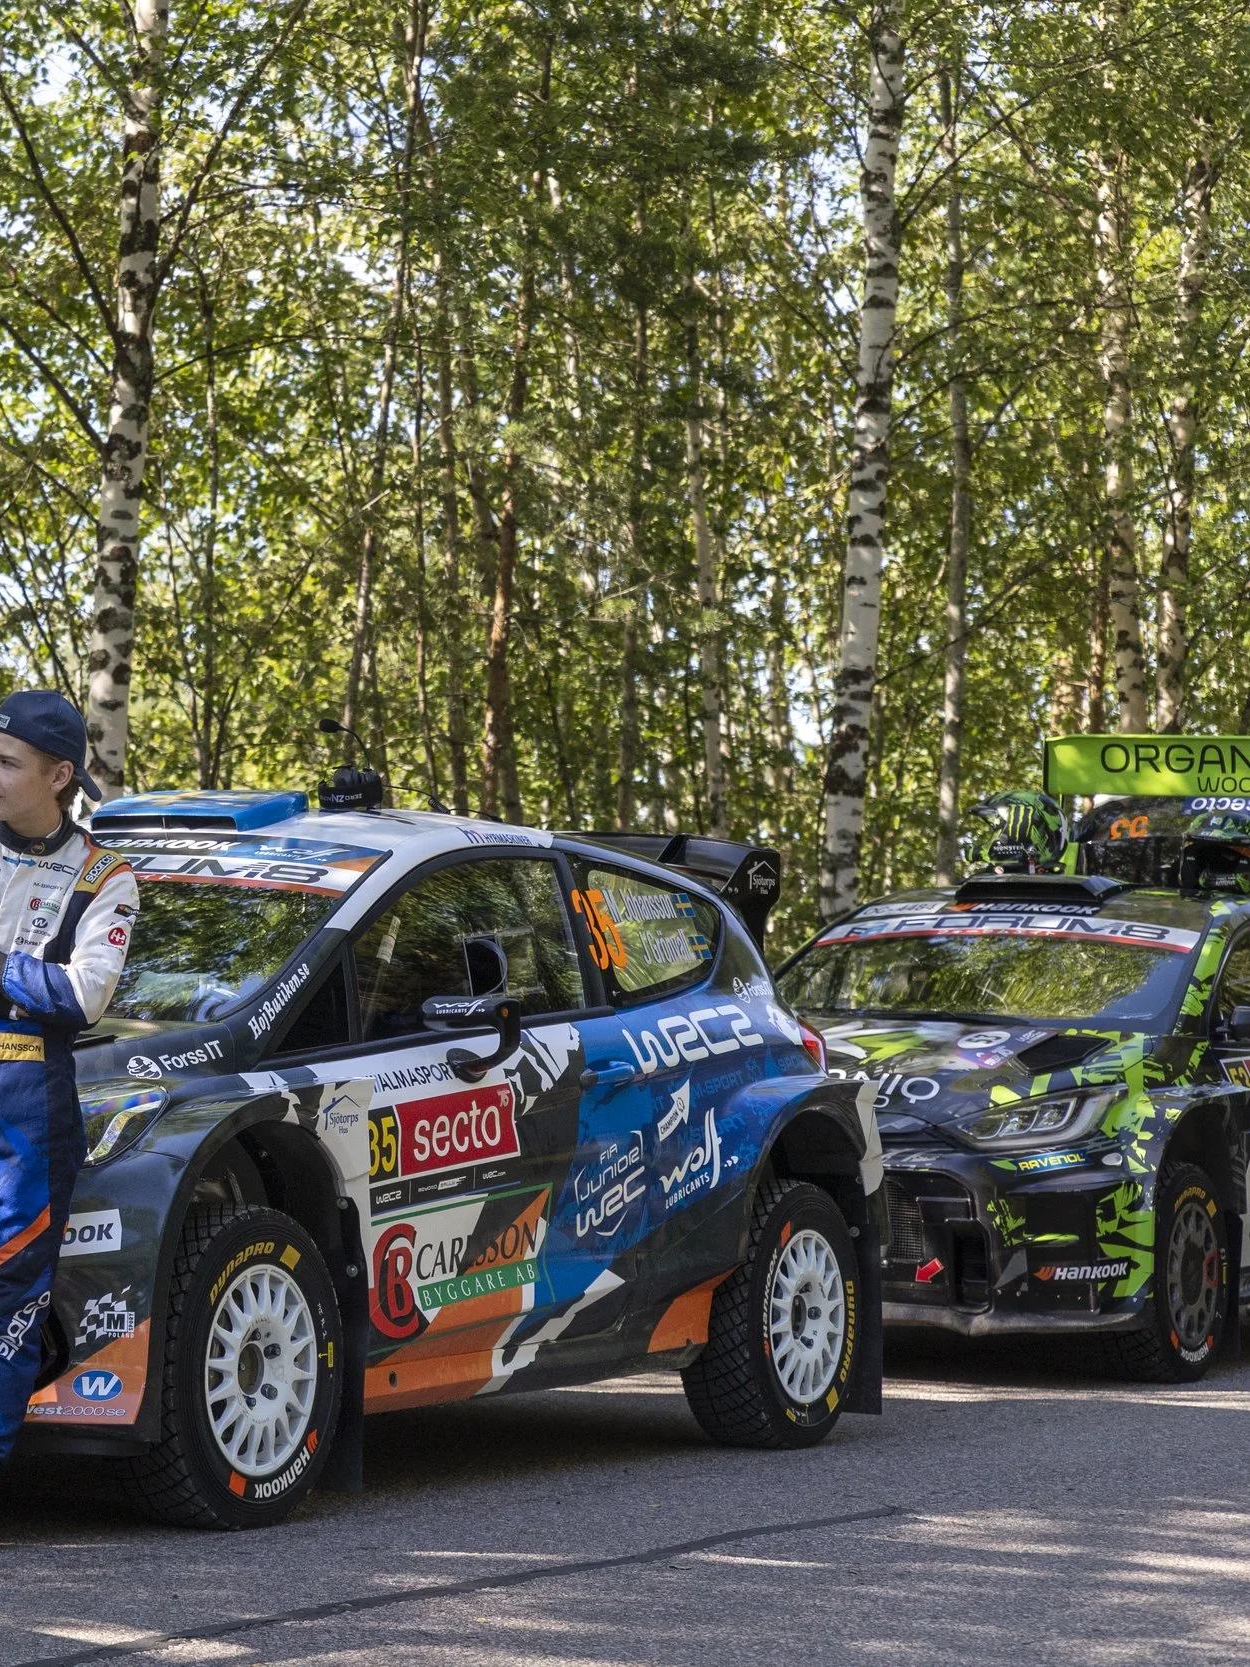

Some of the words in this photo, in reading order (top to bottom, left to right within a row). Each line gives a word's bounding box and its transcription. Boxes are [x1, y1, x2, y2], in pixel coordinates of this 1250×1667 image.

[85, 854, 117, 883] sparco
[619, 888, 677, 921] Johansson
[571, 889, 627, 971] 35
[894, 915, 1171, 941] FORUM8
[158, 1048, 208, 1071] Forss
[207, 1039, 224, 1060] IT
[622, 1004, 764, 1074] WRC2
[328, 1109, 359, 1127] Sjötorps
[338, 1125, 349, 1135] Hus
[413, 1100, 501, 1162] secto
[369, 1116, 397, 1177] 35
[600, 1143, 618, 1164] FIA
[1018, 1153, 1086, 1171] RAVENOL
[580, 1146, 640, 1201] JUNIOR
[576, 1165, 646, 1237] WRC
[665, 1171, 711, 1210] LUBRICANTS
[423, 1270, 506, 1307] BYGGARE
[516, 1263, 536, 1283] AB
[106, 1314, 125, 1330] M
[81, 1375, 120, 1397] W
